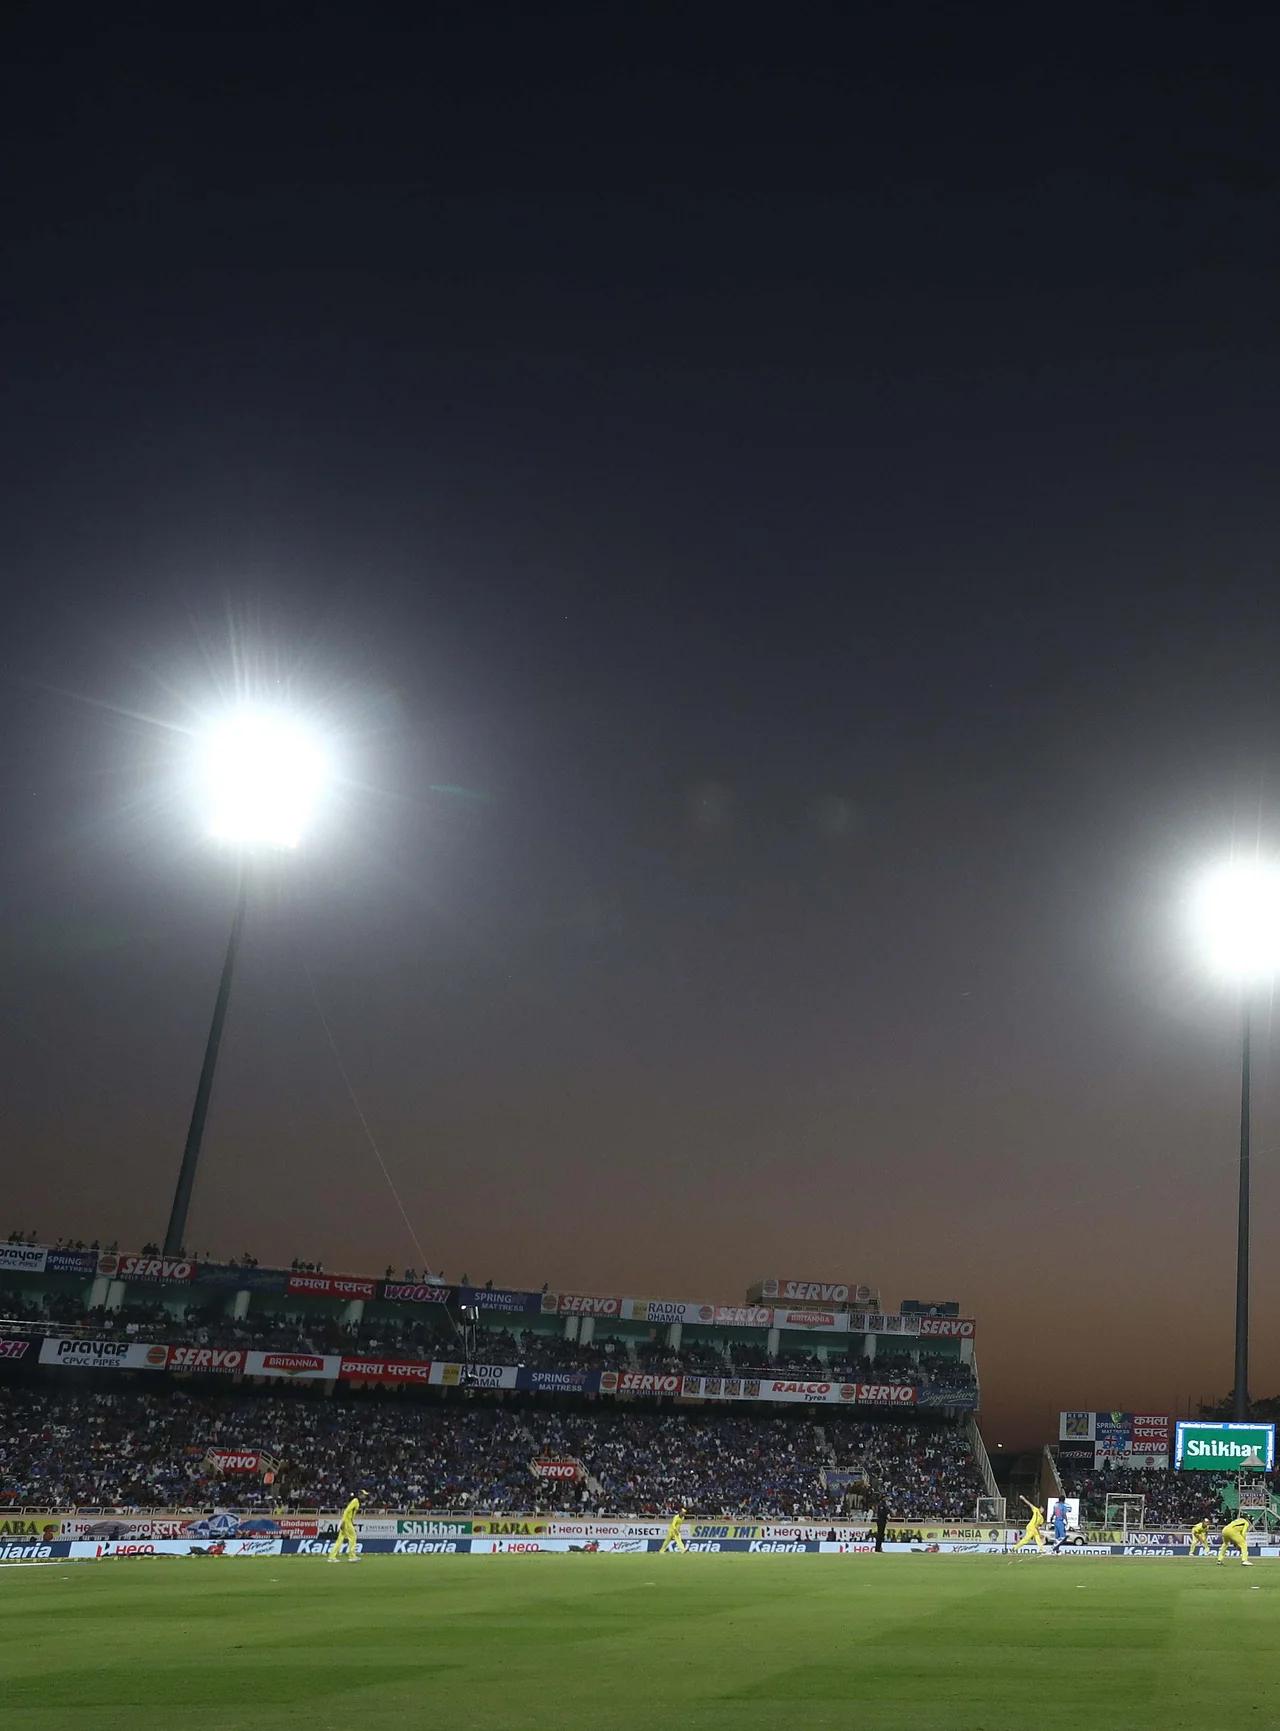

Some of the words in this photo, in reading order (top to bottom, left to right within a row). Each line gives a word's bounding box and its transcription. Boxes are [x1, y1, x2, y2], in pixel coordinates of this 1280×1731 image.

[122, 1257, 192, 1279] SERVO
[784, 1281, 849, 1302] SERVO
[481, 1303, 524, 1313] MATTRESS
[559, 1296, 618, 1314] SERVO
[648, 1302, 686, 1315] RADIO
[715, 1307, 770, 1323] SERVO
[920, 1319, 974, 1336] SERVO
[171, 1347, 242, 1368] SERVO
[269, 1356, 319, 1369] BRITANNIA
[341, 1361, 383, 1375] कमला
[538, 1384, 583, 1393] MATTRESS
[620, 1374, 678, 1391] SERVO
[771, 1381, 831, 1394] RALCO
[804, 1394, 827, 1402] Tyres
[858, 1385, 913, 1401] SERVO
[1133, 1442, 1167, 1452] SERVO
[1187, 1440, 1262, 1457] Shikhar
[216, 1455, 257, 1469] SERVO
[538, 1465, 574, 1477] SERVO
[402, 1521, 466, 1535] Shikhar
[559, 1526, 583, 1535] Hero
[596, 1526, 619, 1535] Hero
[628, 1527, 661, 1536] AISECT
[733, 1527, 758, 1538] TMT
[774, 1527, 801, 1537] Hero
[1128, 1534, 1160, 1545] INDIA
[0, 1542, 52, 1560] jaria
[116, 1543, 154, 1555] Hero
[393, 1540, 457, 1554] Kajaria
[507, 1543, 539, 1552] Hero
[749, 1541, 807, 1553] Kajaria
[1124, 1547, 1174, 1556] Kajaria
